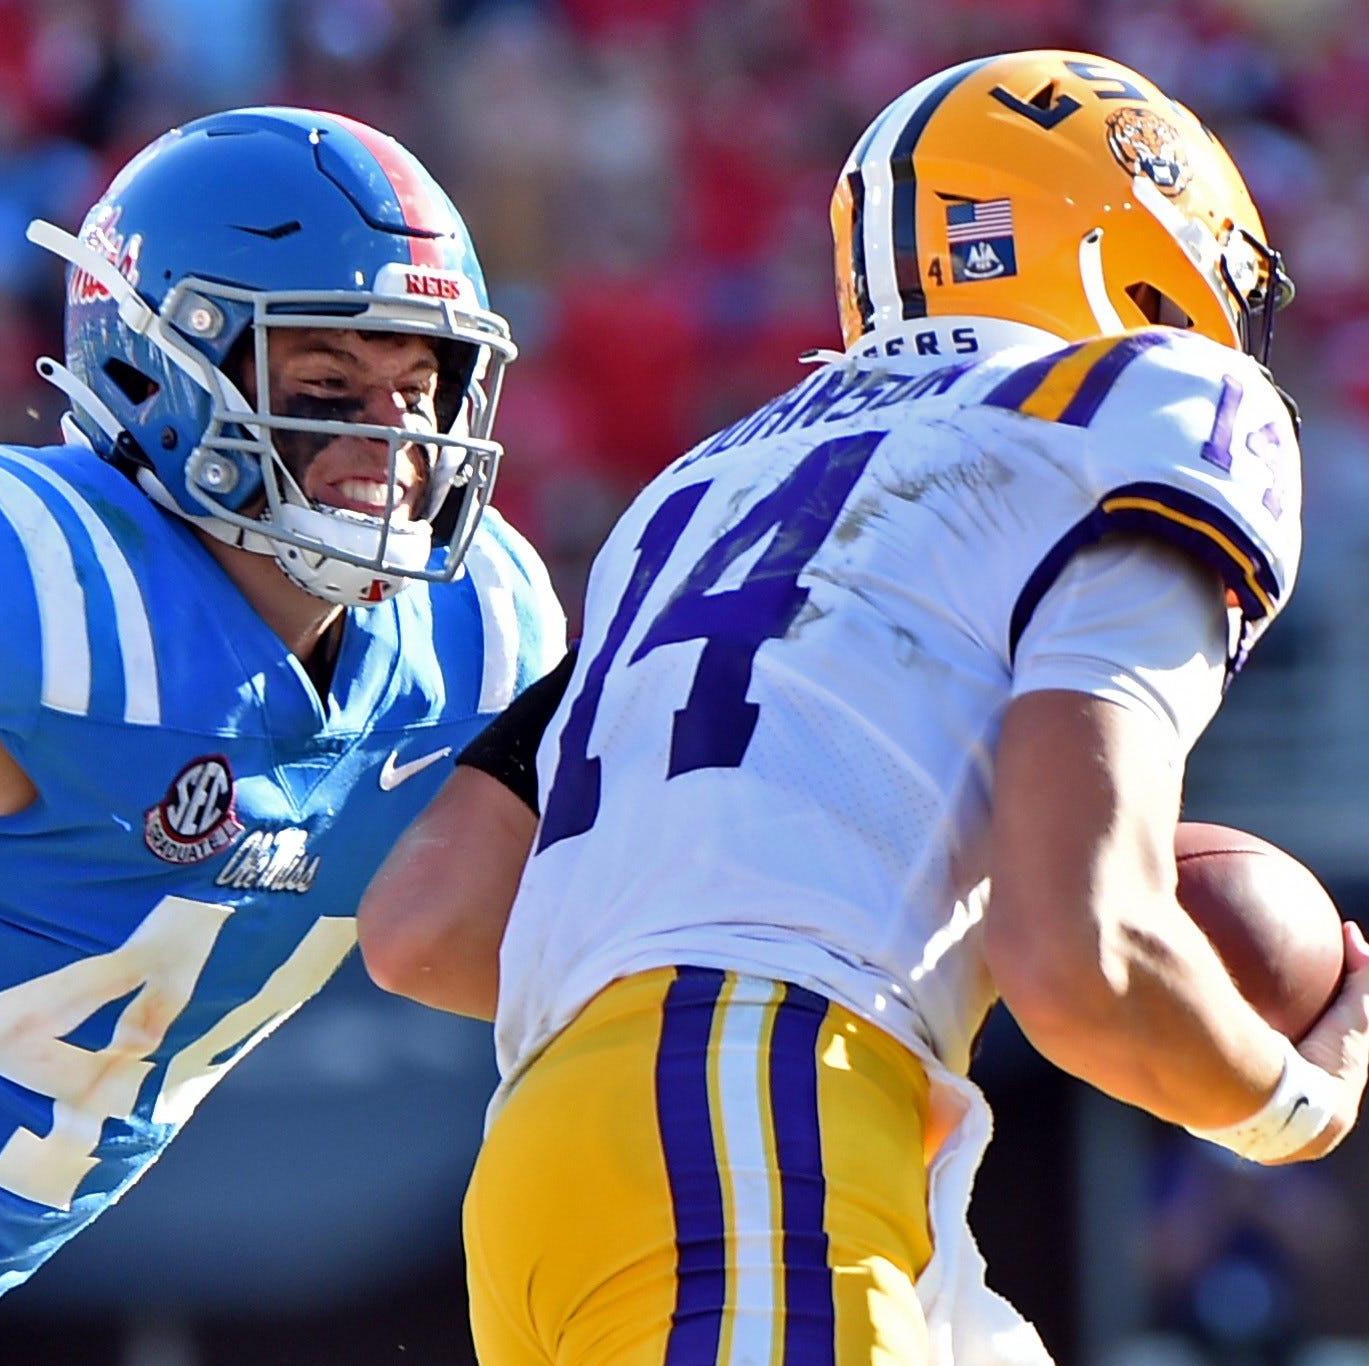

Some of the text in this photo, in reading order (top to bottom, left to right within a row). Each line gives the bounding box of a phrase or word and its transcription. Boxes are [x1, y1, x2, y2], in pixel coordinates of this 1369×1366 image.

[988, 59, 1215, 143] LS
[405, 272, 460, 300] REBS
[928, 256, 944, 287] 4
[1199, 373, 1283, 522] 14
[535, 429, 890, 855] 14
[166, 761, 229, 836] SEC
